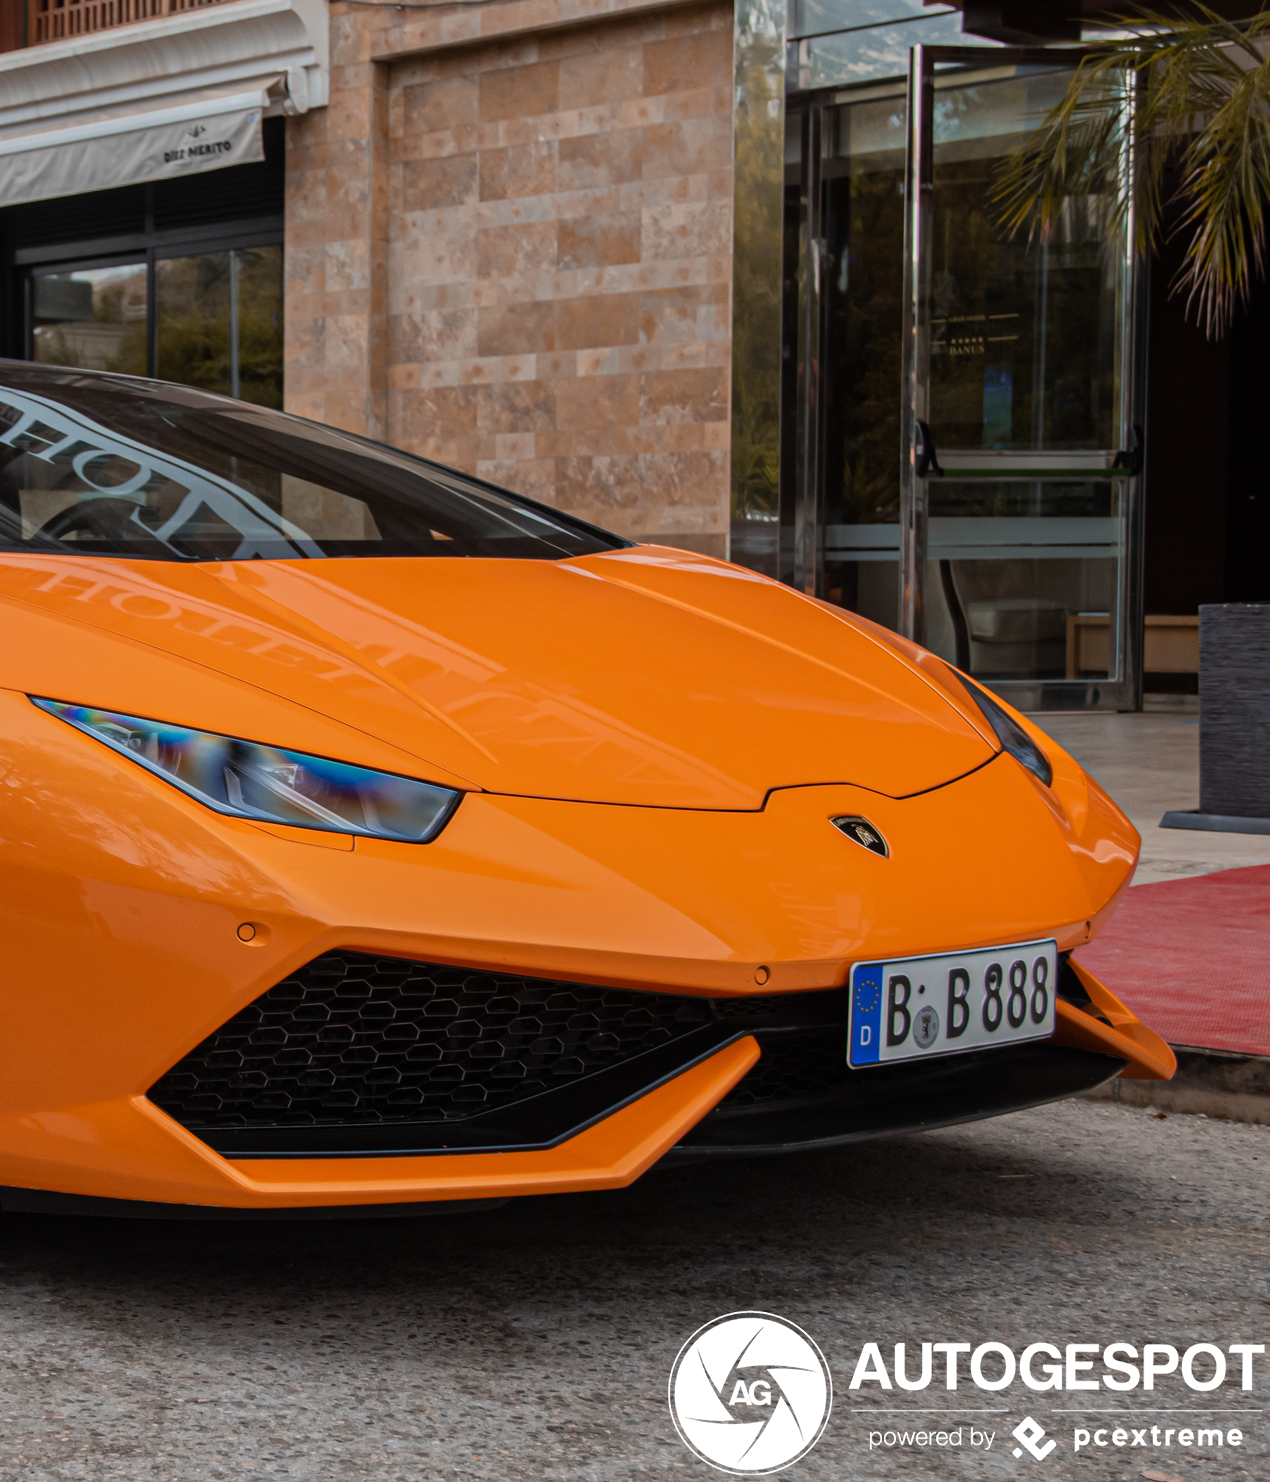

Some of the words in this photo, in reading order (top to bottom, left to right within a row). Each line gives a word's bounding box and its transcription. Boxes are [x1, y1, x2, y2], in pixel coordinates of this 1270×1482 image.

[163, 149, 185, 164] DIEZ
[188, 140, 231, 158] MERITO
[886, 974, 912, 1047] B
[946, 967, 971, 1039] B
[982, 956, 1048, 1033] 888
[860, 1026, 872, 1046] D
